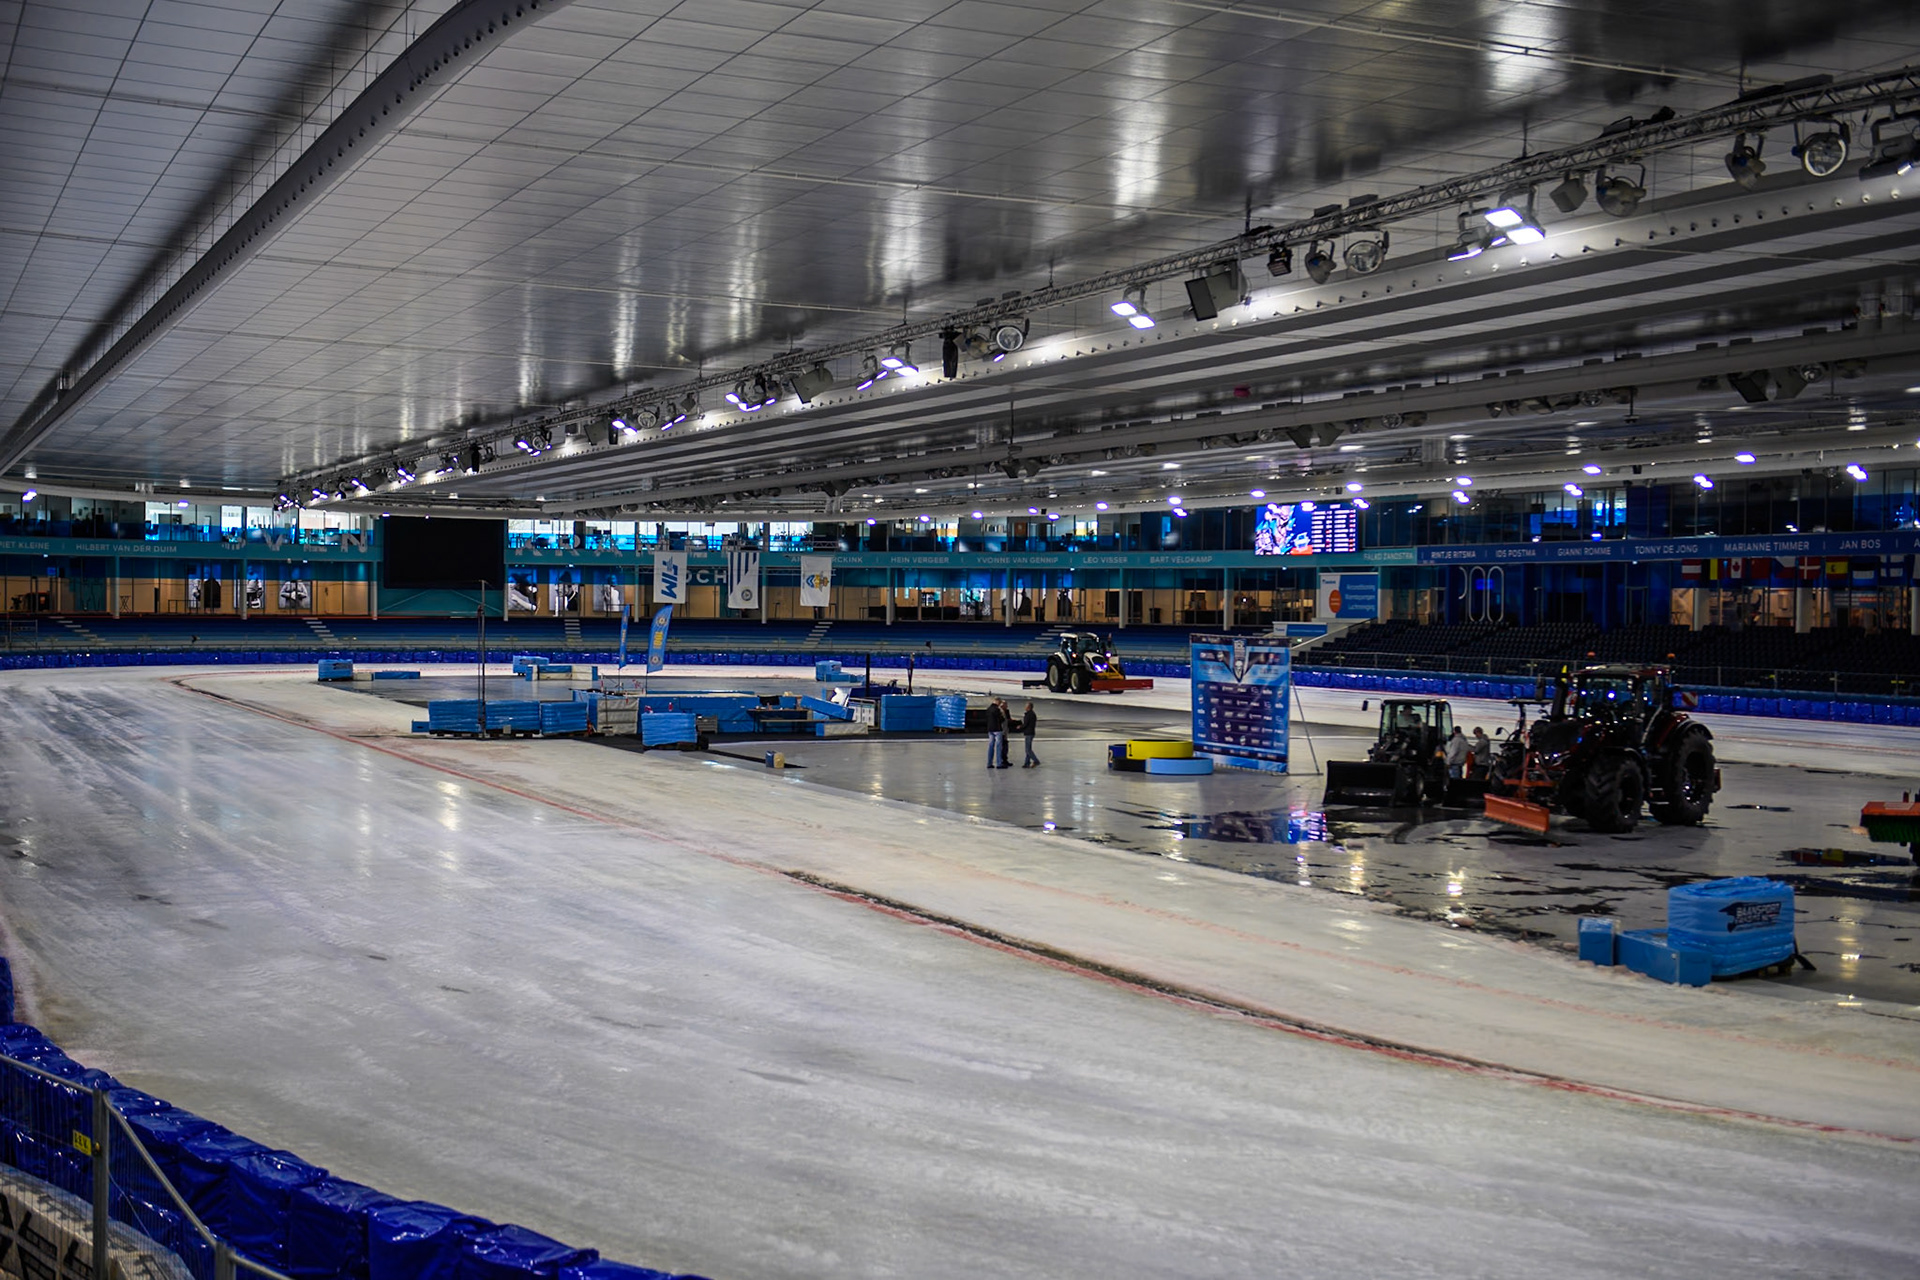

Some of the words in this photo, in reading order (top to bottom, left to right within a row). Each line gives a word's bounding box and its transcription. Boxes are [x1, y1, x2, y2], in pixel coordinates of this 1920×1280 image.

[18, 541, 50, 550] KLEINE
[76, 543, 110, 552] HILBERT
[113, 544, 131, 552] VAN
[153, 545, 177, 553] DUIM
[1635, 545, 1661, 554] TONNY
[1662, 545, 1674, 554] DE
[1675, 544, 1698, 554] JONG
[1724, 542, 1771, 552] MARIANNE
[1773, 541, 1810, 551] TIMMER
[1839, 540, 1858, 550] JAN
[1860, 539, 1881, 549] BOS
[1430, 551, 1452, 559] RINTJE
[1453, 550, 1477, 559] RITSMA
[1495, 549, 1507, 558] IDS
[1508, 549, 1537, 558] POSTMA
[1557, 547, 1582, 557] GIANNI
[1584, 546, 1612, 556] ROMME
[890, 556, 911, 564] HEIN
[912, 556, 950, 564] VERGEER
[976, 556, 1011, 564] YVONNE
[1083, 556, 1099, 564] LEO
[1100, 556, 1128, 564] VISSER
[1149, 556, 1169, 564] BART
[661, 560, 678, 600] FIM
